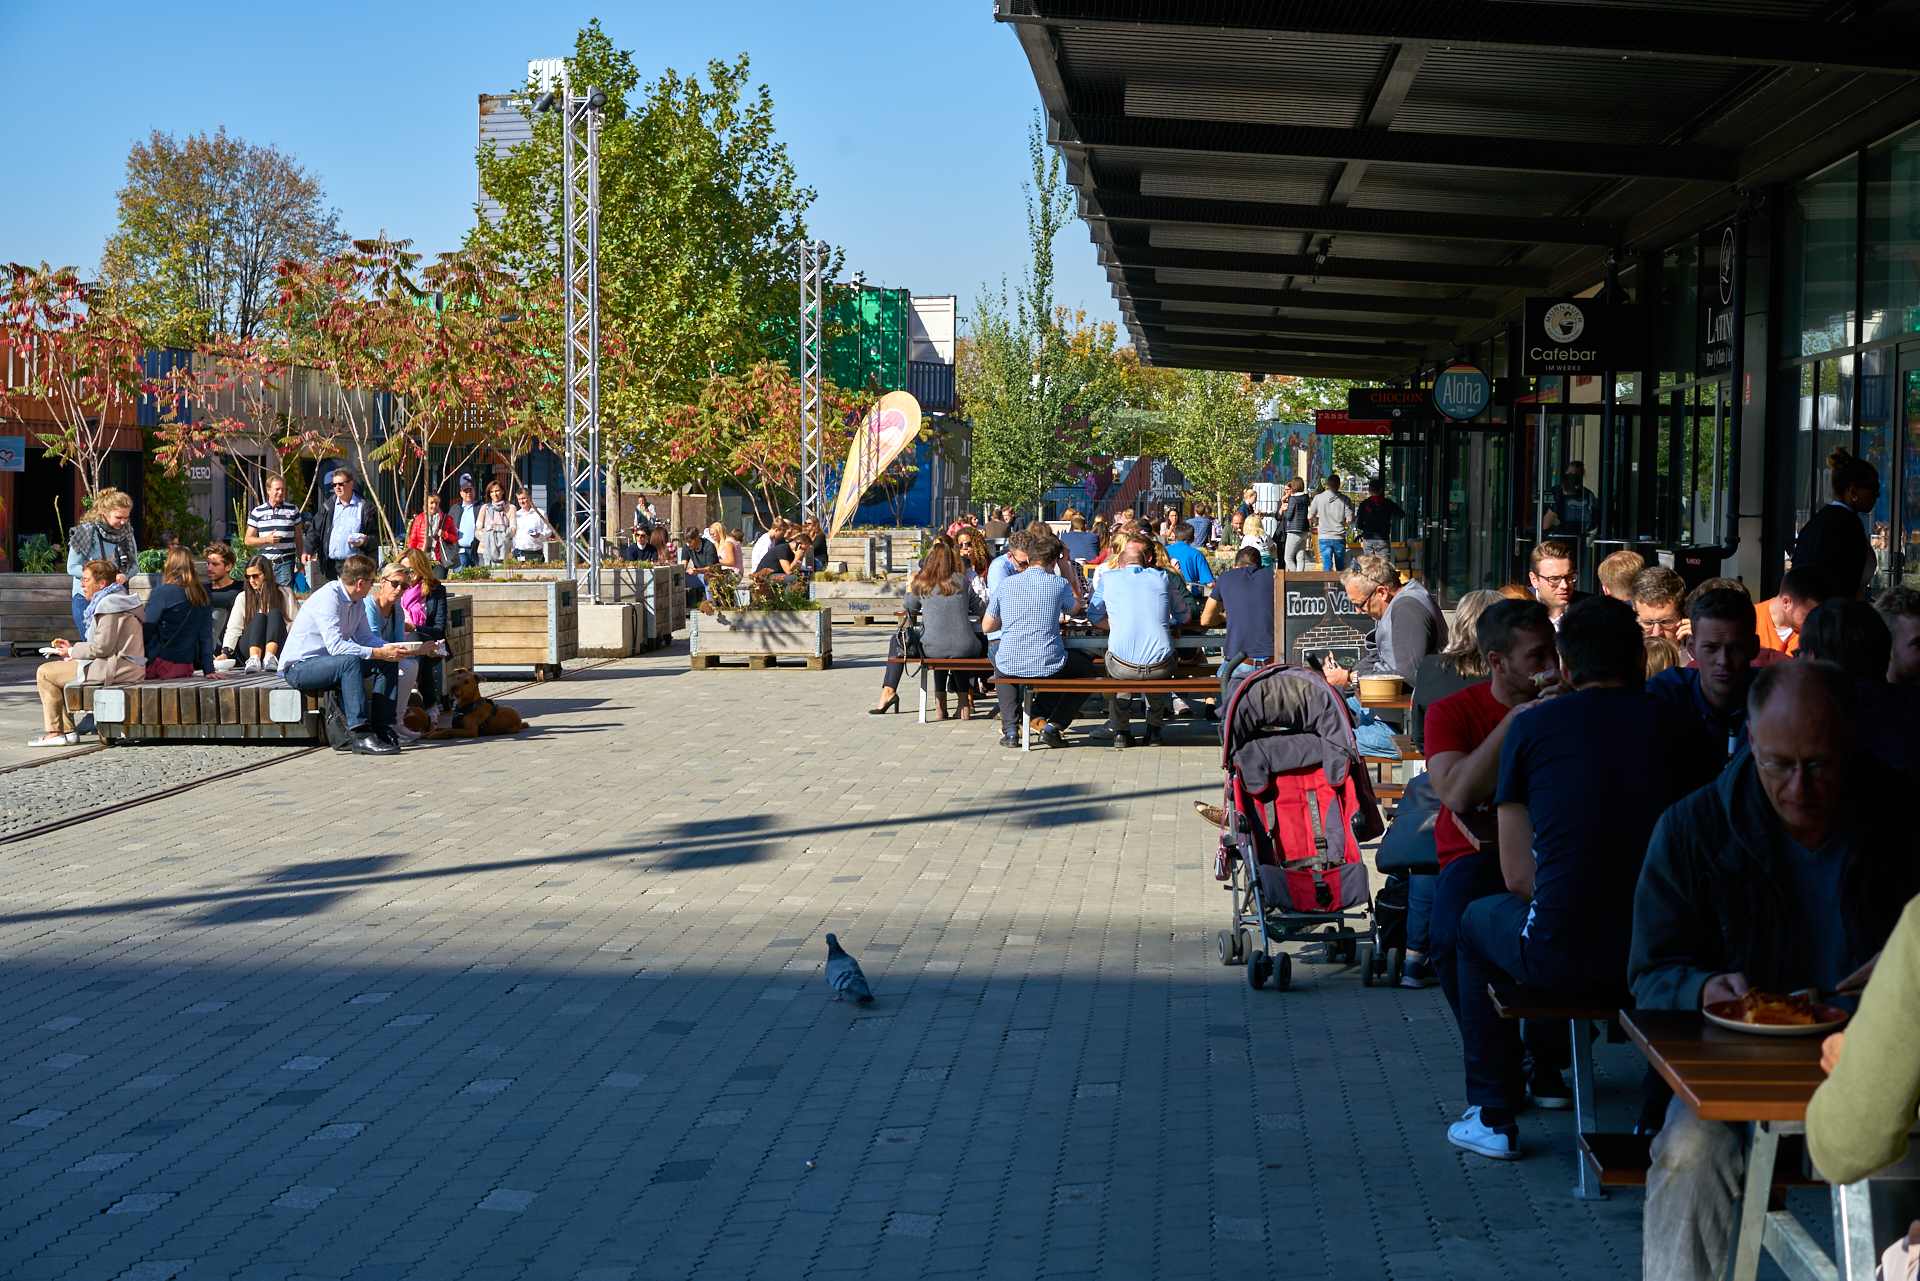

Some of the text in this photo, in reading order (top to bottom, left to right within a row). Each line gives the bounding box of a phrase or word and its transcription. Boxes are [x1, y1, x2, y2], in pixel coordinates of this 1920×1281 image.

[1546, 305, 1582, 322] MURNAUER
[1530, 347, 1597, 361] Cafebar
[1716, 348, 1725, 364] Club
[1370, 392, 1423, 403] CHOCION
[1442, 375, 1481, 405] Aloha
[191, 466, 211, 480] ZERO
[1286, 591, 1327, 616] Forno
